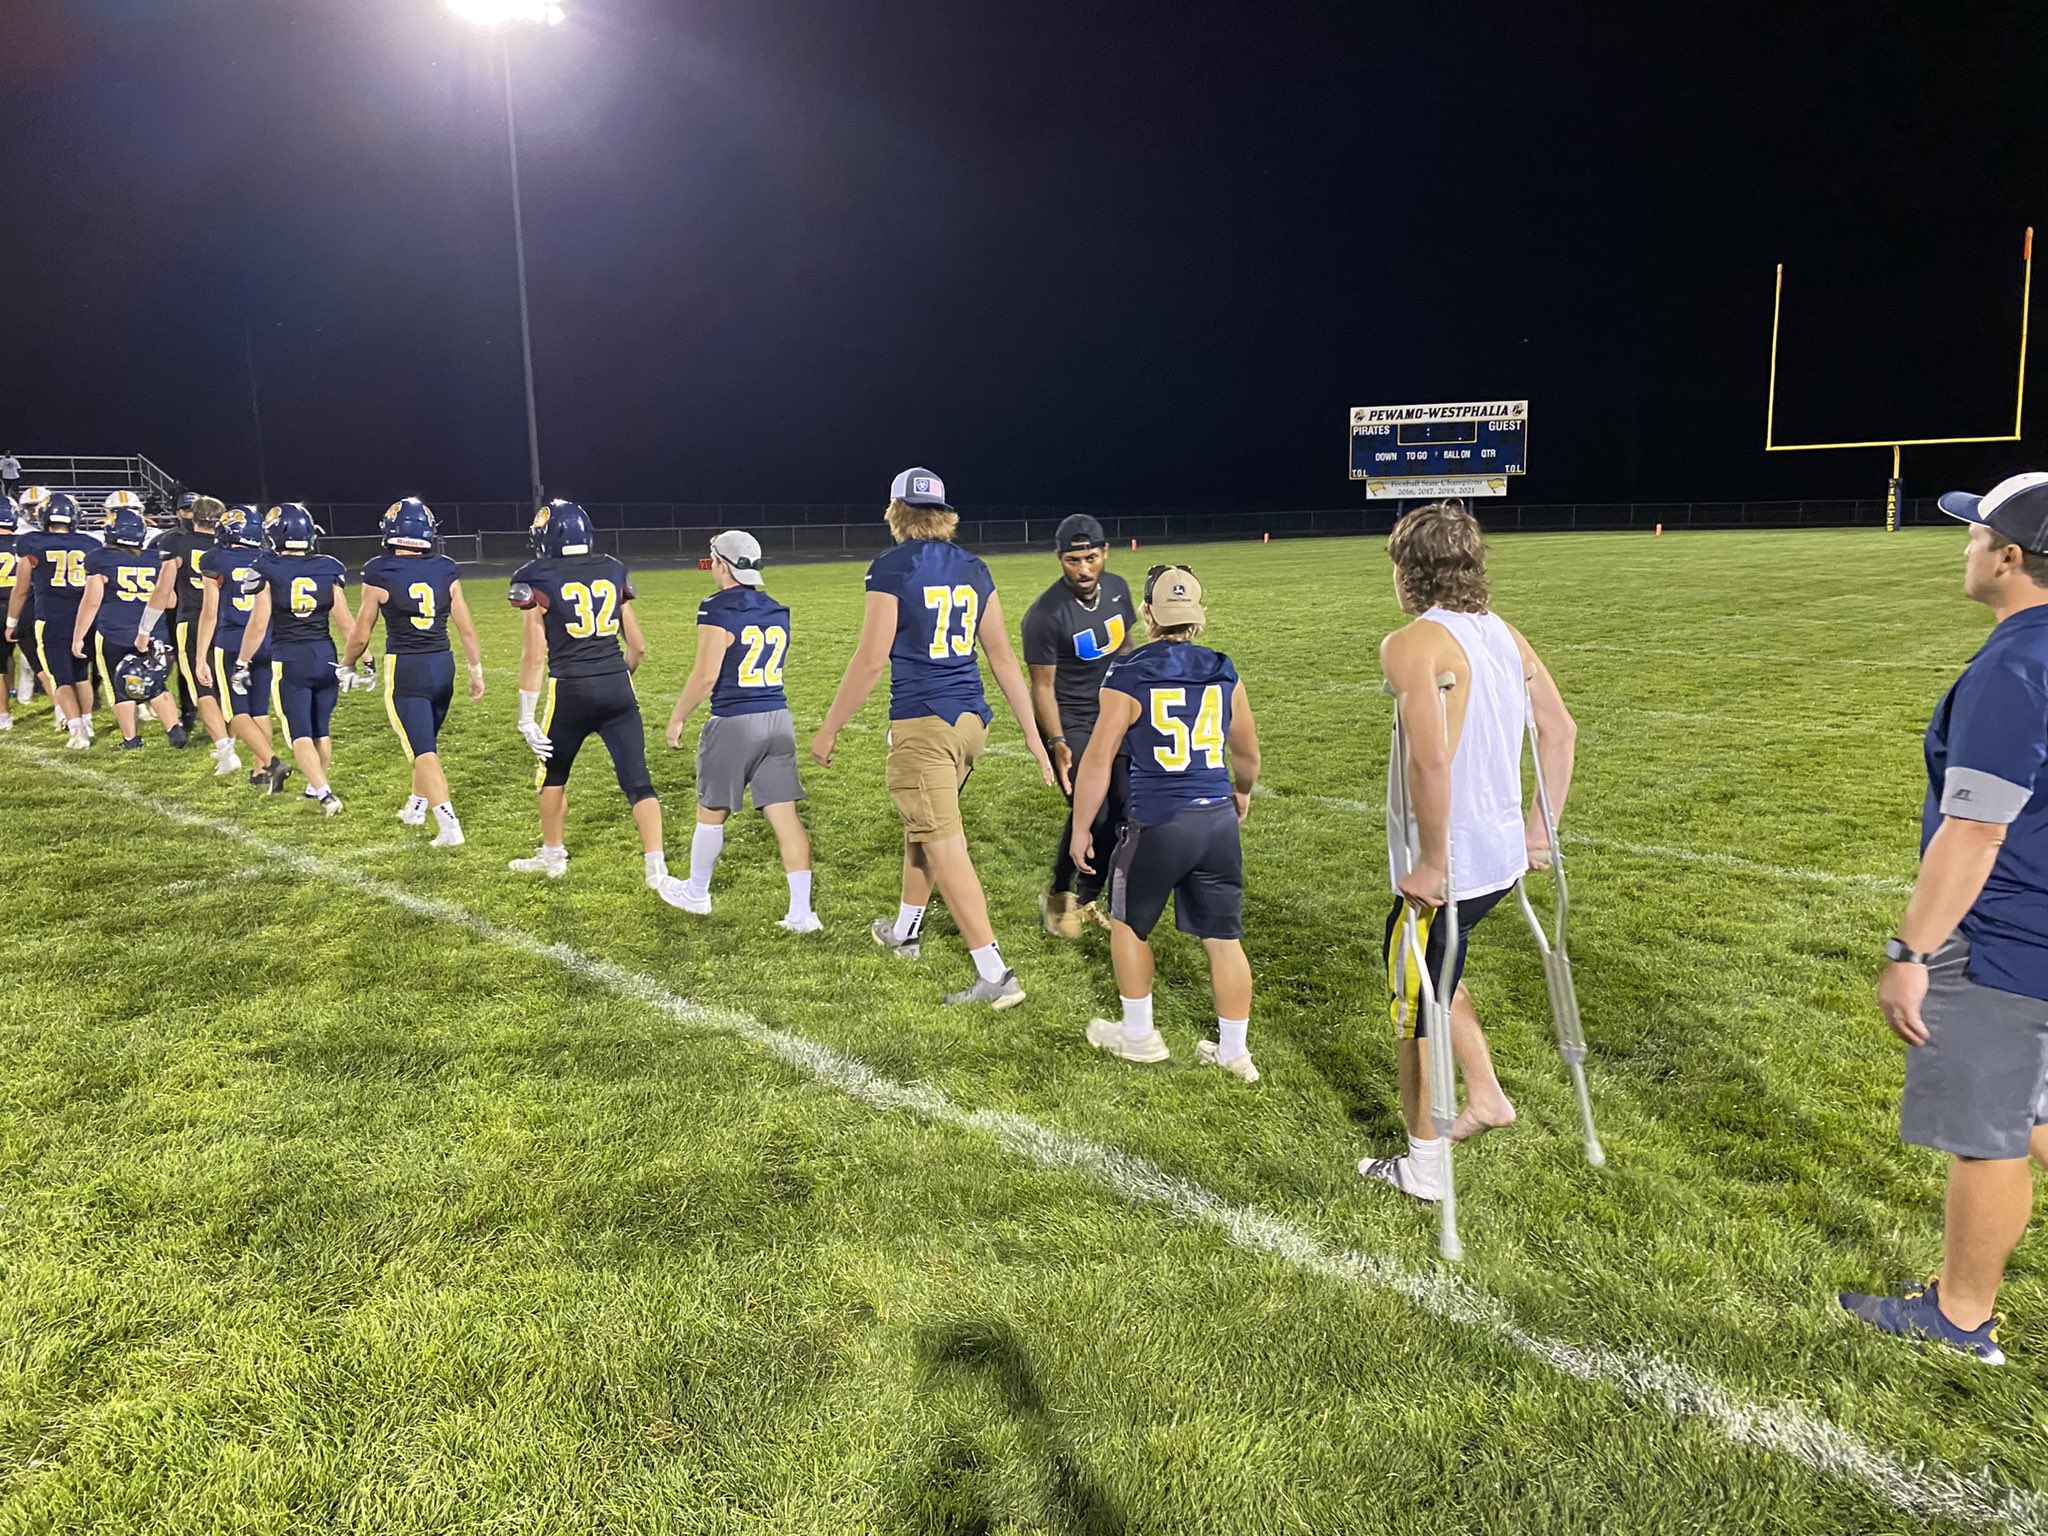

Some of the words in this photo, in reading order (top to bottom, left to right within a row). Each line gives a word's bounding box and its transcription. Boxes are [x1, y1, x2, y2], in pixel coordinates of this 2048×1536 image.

[1368, 405, 1509, 421] PEWAMO-WESTPHALIA
[1488, 420, 1522, 431] GUEST
[1353, 426, 1390, 436] PIRATES
[1375, 452, 1397, 461] DOWN
[1406, 451, 1416, 460] TO
[1417, 451, 1428, 460] GO
[1443, 450, 1460, 459] BALL
[1460, 449, 1471, 458] ON
[1481, 449, 1496, 458] QTR
[1441, 478, 1483, 487] Champions
[46, 550, 87, 587] 76
[116, 566, 156, 602] 55
[290, 577, 317, 617] 6
[408, 582, 436, 630] 3
[560, 578, 620, 639] 32
[923, 584, 979, 660] 73
[737, 625, 788, 688] 22
[1150, 684, 1226, 772] 54
